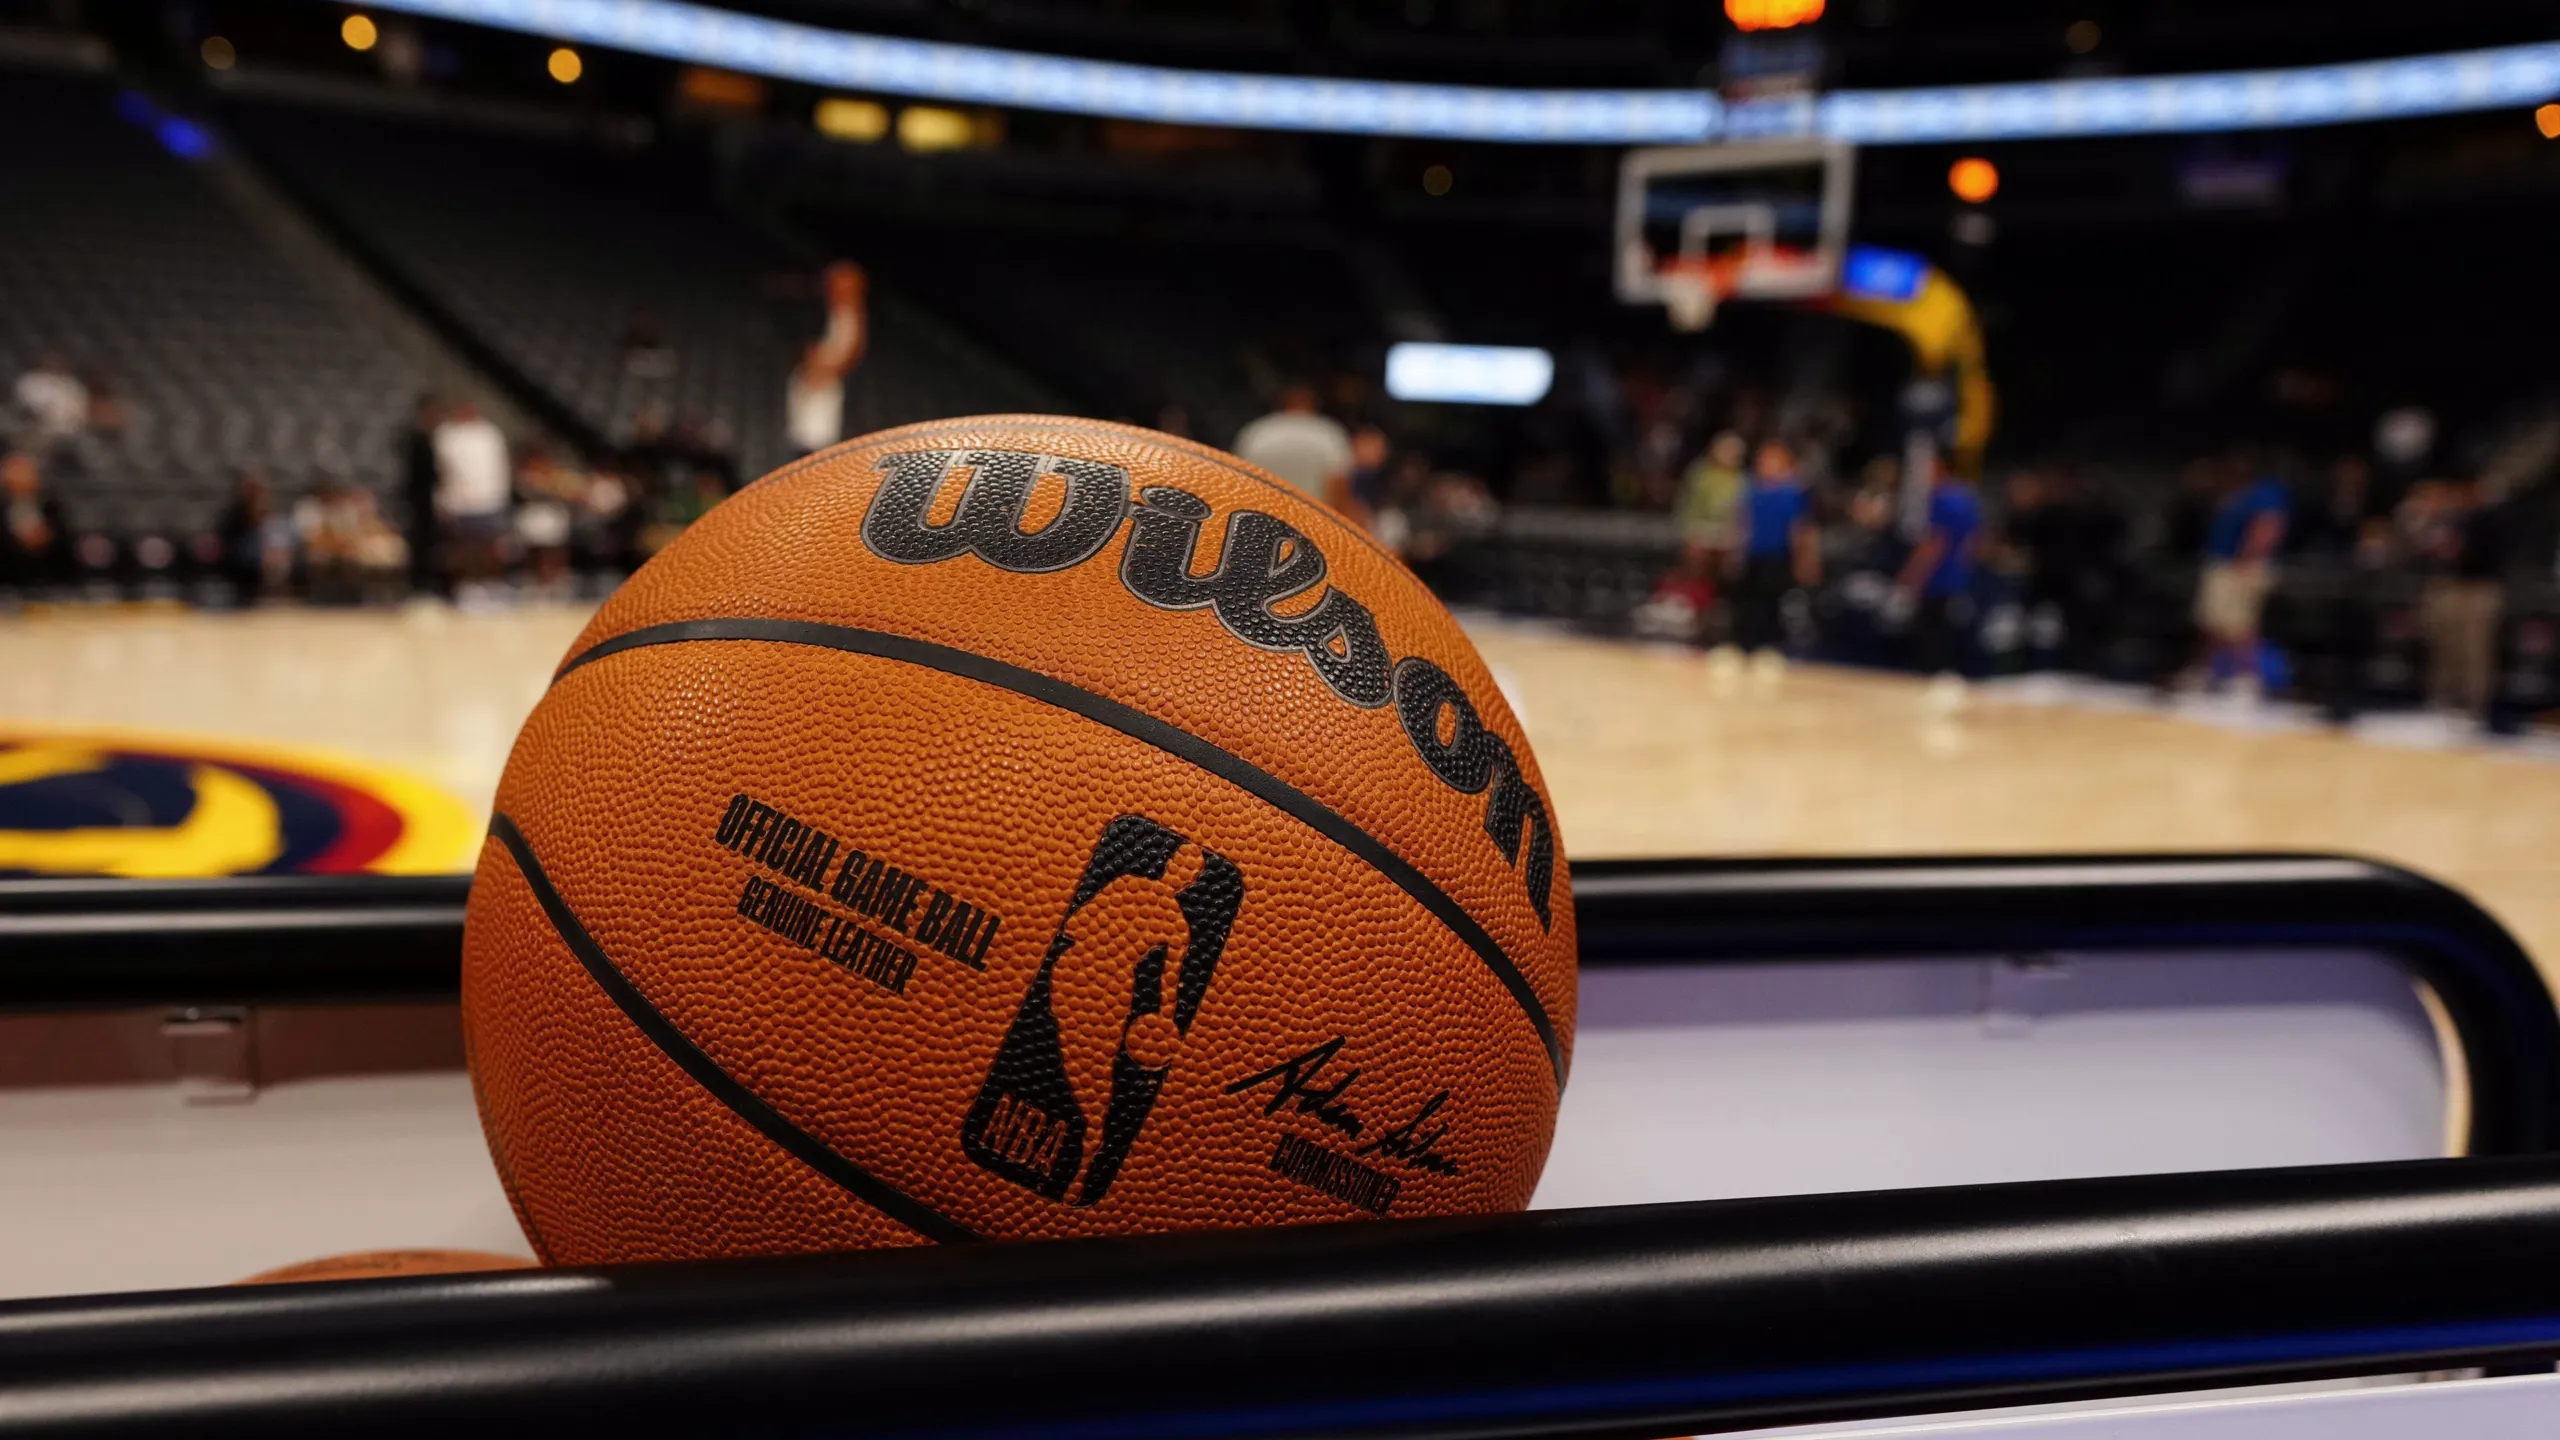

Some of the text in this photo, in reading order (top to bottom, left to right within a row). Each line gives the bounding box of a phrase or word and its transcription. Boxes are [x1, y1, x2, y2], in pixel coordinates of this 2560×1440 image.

[860, 449, 1554, 935] Wilson
[715, 794, 1001, 971] OFFICIAL GAME BALL
[737, 875, 918, 995] GENUINE LEATHER
[978, 1094, 1067, 1177] NBA
[1269, 1133, 1400, 1215] COMMISSIONER
